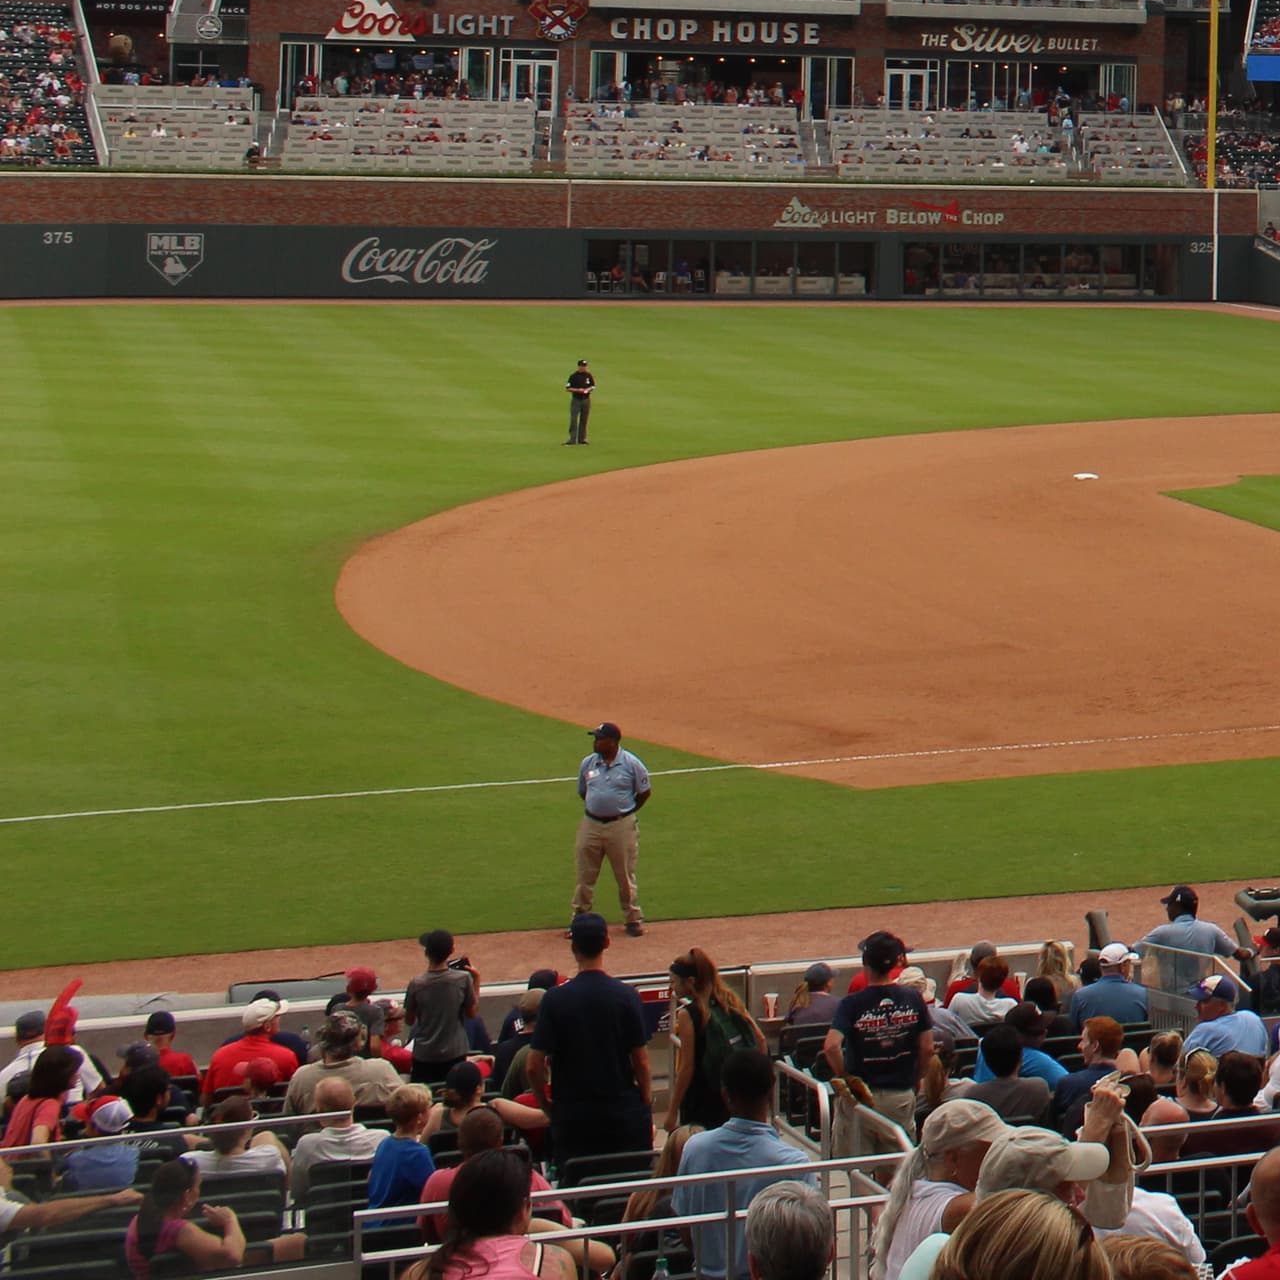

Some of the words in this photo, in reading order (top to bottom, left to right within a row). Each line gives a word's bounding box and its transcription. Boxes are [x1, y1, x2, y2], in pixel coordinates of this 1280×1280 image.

[120, 3, 141, 11] DOG
[334, 0, 428, 36] Coors
[432, 13, 515, 37] LIGHT
[610, 17, 699, 42] CHOP
[712, 20, 820, 45] HOUSE
[921, 33, 949, 48] THE
[950, 23, 1046, 54] Silver
[1048, 37, 1099, 51] BULLET
[831, 211, 877, 224] LIGHT
[886, 208, 942, 225] BELOW
[962, 209, 1005, 225] CHOP
[42, 231, 73, 245] 375
[150, 235, 201, 251] MLB
[1190, 241, 1214, 254] 325
[342, 236, 498, 284] Coca-Cola
